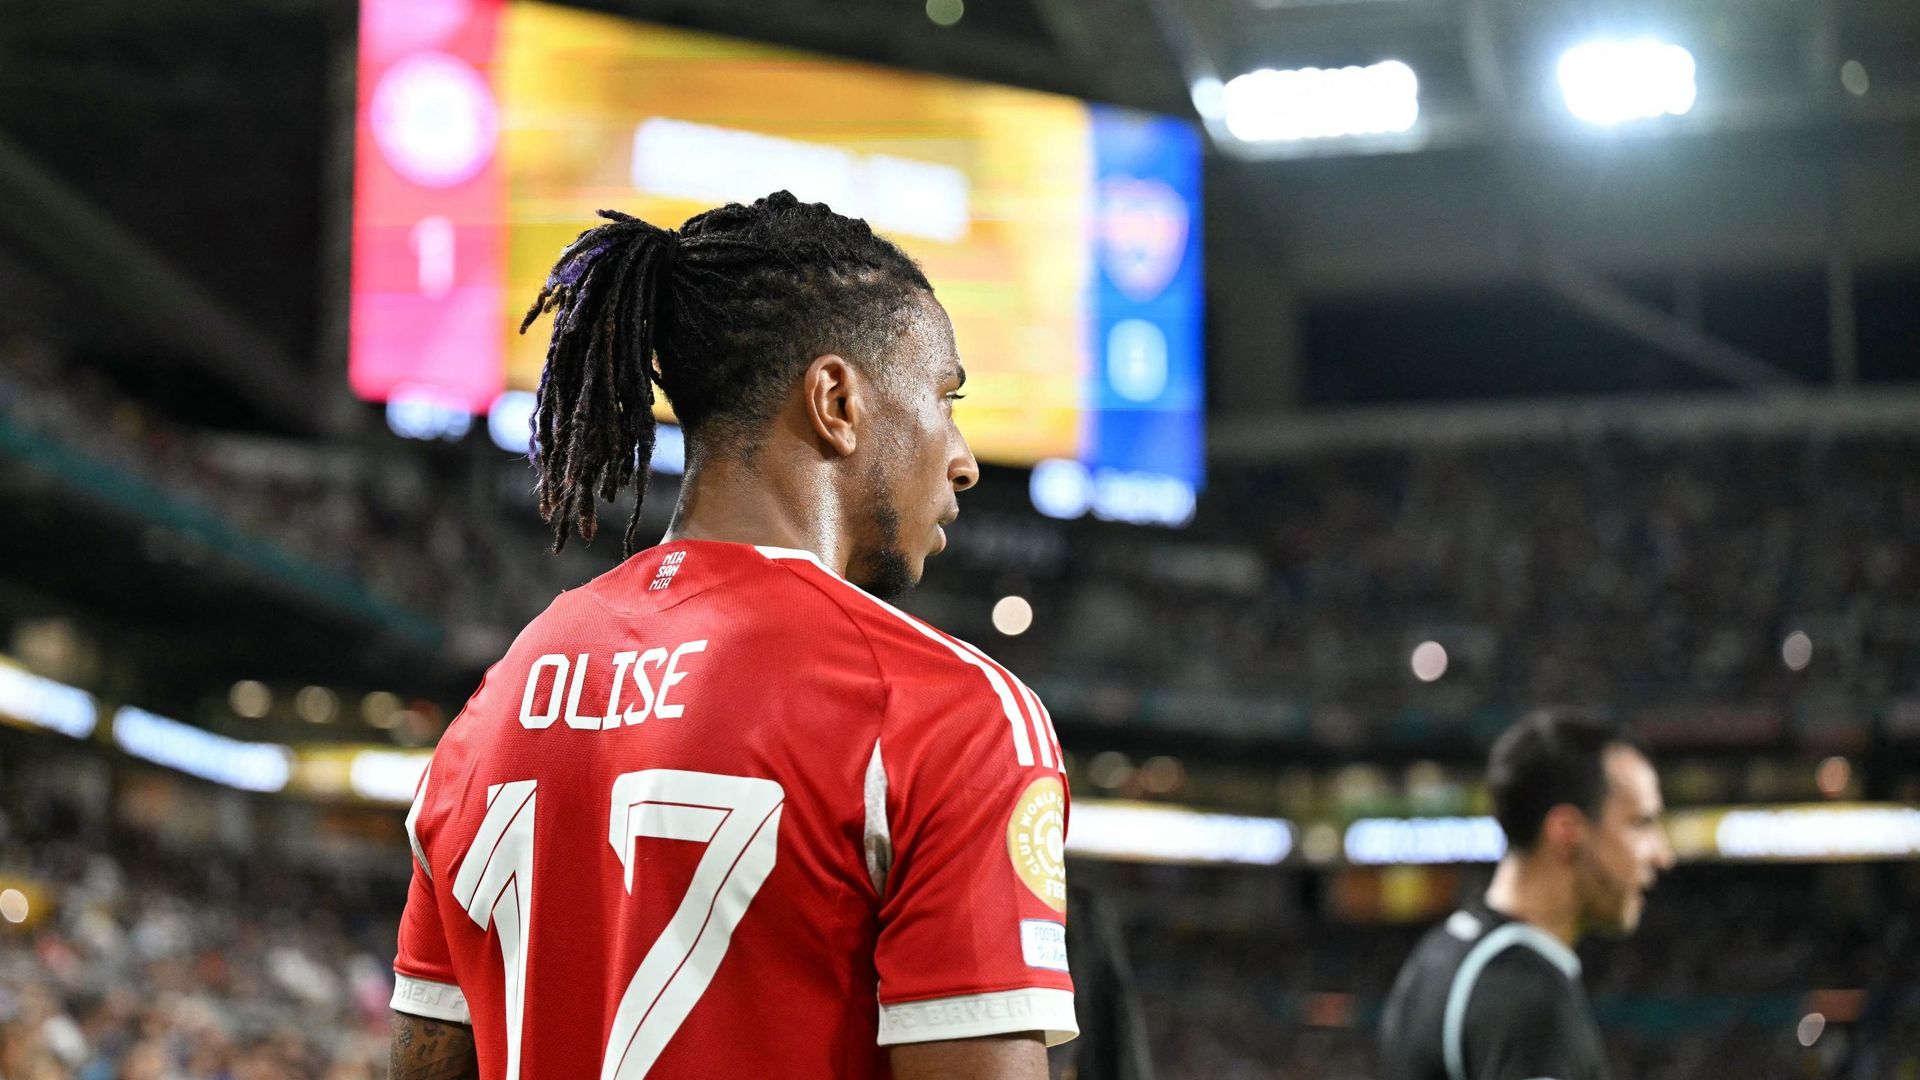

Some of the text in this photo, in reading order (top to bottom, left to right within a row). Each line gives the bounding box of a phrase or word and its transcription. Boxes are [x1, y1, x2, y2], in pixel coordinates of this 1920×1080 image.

[656, 564, 680, 578] SAN
[662, 551, 687, 565] MIA
[648, 577, 672, 591] MIA
[518, 639, 709, 731] OLISE
[1018, 791, 1057, 876] CLUB WORLD
[452, 768, 785, 1080] 17
